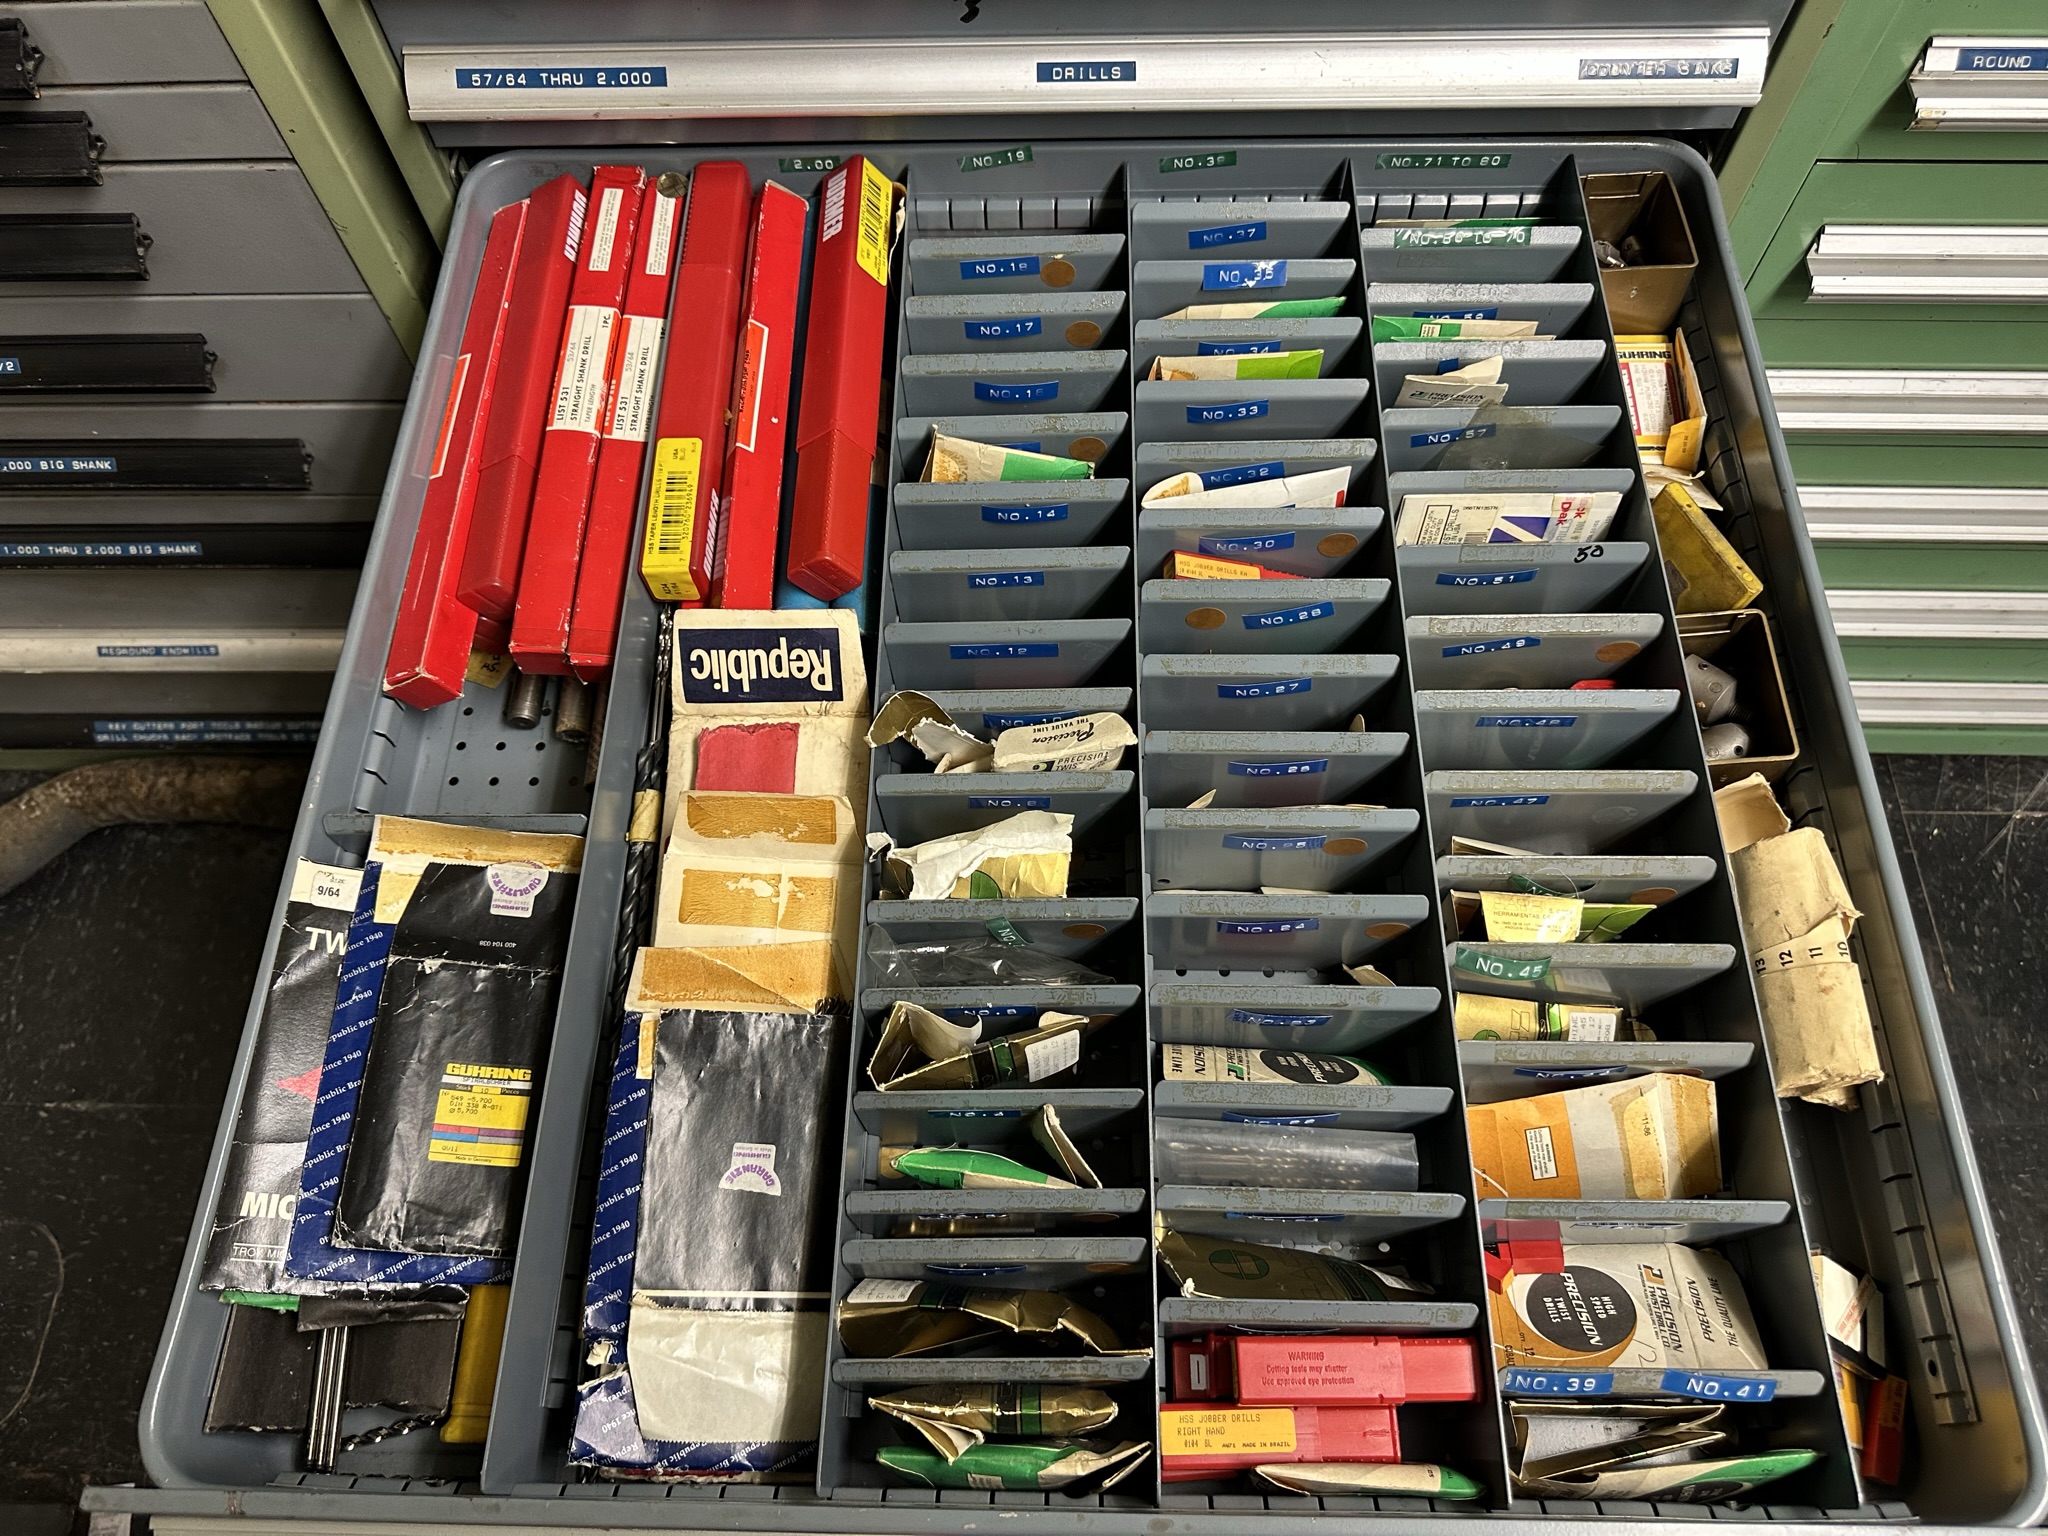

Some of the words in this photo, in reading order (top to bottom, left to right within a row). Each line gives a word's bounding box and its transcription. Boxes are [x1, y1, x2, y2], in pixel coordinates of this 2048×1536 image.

[1973, 55, 2032, 68] ROUND
[472, 73, 527, 86] 57/64
[540, 73, 584, 86] THRU
[597, 72, 652, 85] 2.000
[1052, 66, 1121, 80] DRILLS
[793, 159, 834, 170] 2.00
[972, 150, 1026, 168] NO.19
[1391, 156, 1442, 167] NO.71
[1452, 156, 1471, 167] TO
[1479, 155, 1501, 166] 80
[1203, 228, 1256, 243] NO.37
[980, 320, 1034, 336] NO.17
[566, 342, 577, 362] 53/64
[582, 335, 592, 355] DRILL
[625, 351, 635, 372] 53/64
[640, 346, 650, 366] DRILL
[578, 358, 588, 384] SHANK
[635, 369, 646, 394] SHANK
[559, 386, 570, 402] 531
[587, 383, 597, 405] LENGTH
[989, 387, 1044, 399] NO.16
[570, 385, 583, 421] STRAIGHT
[618, 396, 628, 412] 531
[556, 404, 566, 421] LIST
[584, 406, 593, 423] TAPER
[629, 396, 642, 432] STRAIGHT
[1203, 405, 1259, 420] NO.33
[615, 414, 625, 431] LIST
[1427, 428, 1487, 444] NO.57
[40, 460, 64, 471] BIG
[72, 459, 111, 470] SHANK
[1210, 467, 1270, 484] NO.32
[997, 508, 1056, 521] NO.14
[1445, 508, 1460, 532] DRILLS
[649, 522, 657, 541] TAPER
[49, 545, 77, 555] THRU
[85, 545, 122, 555] 2.000
[129, 544, 152, 555] BIG
[159, 544, 197, 554] SHANK
[1216, 539, 1276, 551] NO.30
[1573, 545, 1605, 563] 50
[1216, 566, 1237, 575] DRILLS
[975, 575, 1034, 586] NO.13
[1454, 575, 1515, 586] NO.51
[1260, 608, 1322, 625] NO.28
[966, 646, 1028, 657] NO.12
[1460, 639, 1526, 655] NO.49
[690, 636, 834, 693] Republic
[1235, 682, 1299, 697] NO.27
[1051, 721, 1074, 732] VALUE
[1077, 717, 1089, 725] THE
[1032, 722, 1095, 745] Precision
[1033, 726, 1049, 734] LINE
[317, 885, 341, 897] 9/64
[1493, 910, 1540, 919] HERRAMIENTAS
[1237, 923, 1305, 933] NO.24
[365, 931, 384, 944] 1940
[1755, 957, 1766, 975] 13
[1779, 949, 1794, 967] 12
[1808, 946, 1823, 959] 11
[1836, 941, 1849, 957] 10
[1475, 957, 1543, 979] NO.45
[354, 989, 373, 1002] 1940
[343, 1049, 362, 1062] 1940
[1171, 1056, 1183, 1073] LINE
[627, 1087, 647, 1102] 1940
[331, 1111, 351, 1125] 1940
[620, 1152, 639, 1167] 1940
[319, 1176, 340, 1190] 1940
[612, 1219, 631, 1235] 1940
[233, 1246, 264, 1258] TROY
[315, 1254, 356, 1280] Republic
[1707, 1276, 1722, 1295] LINE
[604, 1288, 623, 1303] 1940
[1542, 1297, 1561, 1323] DRILLS
[1554, 1296, 1572, 1321] TWIST
[1560, 1272, 1604, 1346] PRECISION
[1589, 1296, 1607, 1319] SPEED
[1600, 1296, 1618, 1315] HIGH
[1648, 1285, 1659, 1311] TWIST
[1654, 1310, 1667, 1333] DRILL
[1685, 1276, 1715, 1343] PRECISION
[1714, 1295, 1734, 1329] QUALITY
[1655, 1286, 1684, 1353] PRECISION
[1724, 1331, 1739, 1347] THE
[1288, 1351, 1325, 1361] WARNING
[1524, 1347, 1535, 1357] 12
[1266, 1364, 1290, 1374] Cutting
[1291, 1364, 1307, 1373] tools
[1309, 1366, 1323, 1374] may
[1324, 1364, 1348, 1373] shatter
[1262, 1376, 1275, 1386] Use
[1277, 1376, 1306, 1387] approved
[1308, 1377, 1320, 1387] eye
[1322, 1375, 1355, 1386] protection
[1515, 1374, 1597, 1392] NO.39
[1686, 1378, 1766, 1398] NO.41
[601, 1417, 621, 1433] 1940
[1179, 1414, 1194, 1423] HSS
[1199, 1414, 1227, 1423] JOBBER
[1231, 1413, 1261, 1423] DRILLS
[1177, 1427, 1202, 1436] RIGHT
[1205, 1426, 1225, 1436] HAND
